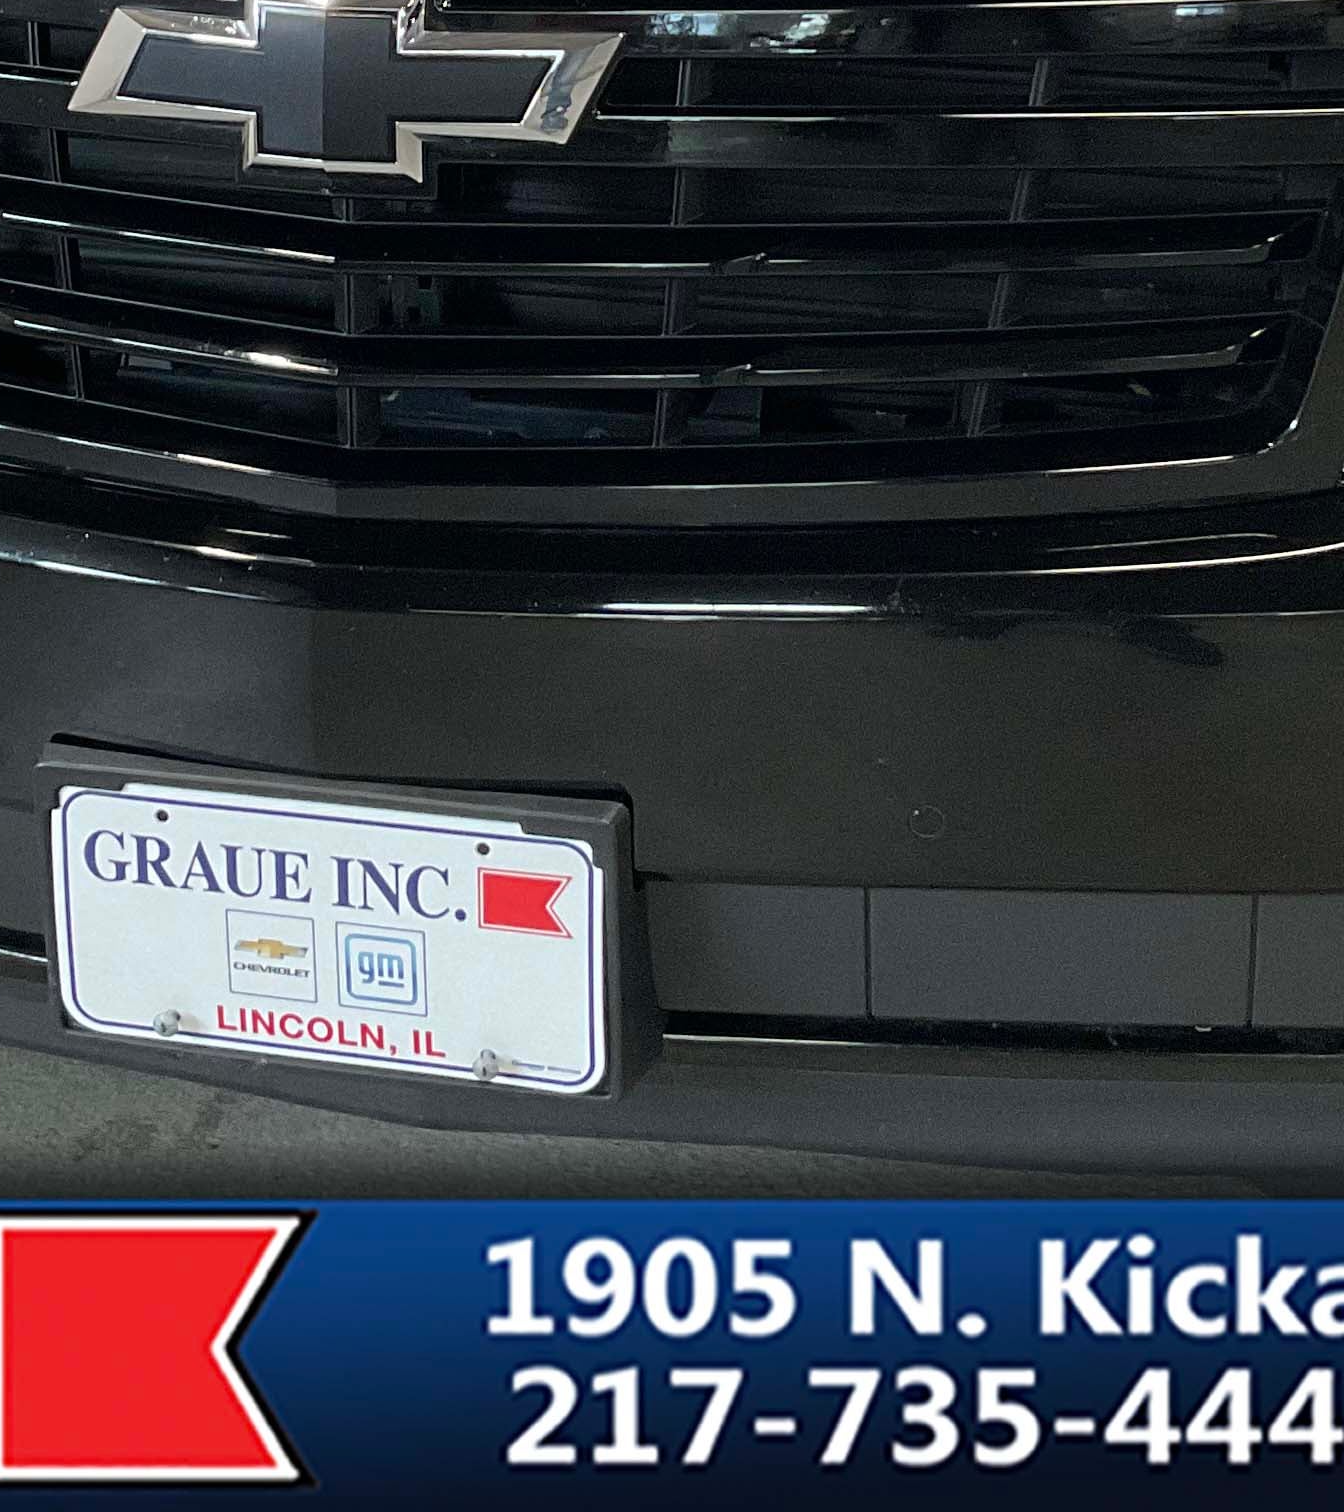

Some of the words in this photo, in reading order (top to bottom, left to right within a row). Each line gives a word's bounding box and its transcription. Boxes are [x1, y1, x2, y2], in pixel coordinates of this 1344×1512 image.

[83, 828, 313, 905] GRAUE
[330, 855, 467, 922] INC.
[232, 960, 312, 979] CHEVROLET
[357, 951, 405, 988] gm
[216, 1004, 398, 1056] LINCOLN,
[412, 1029, 447, 1059] IL
